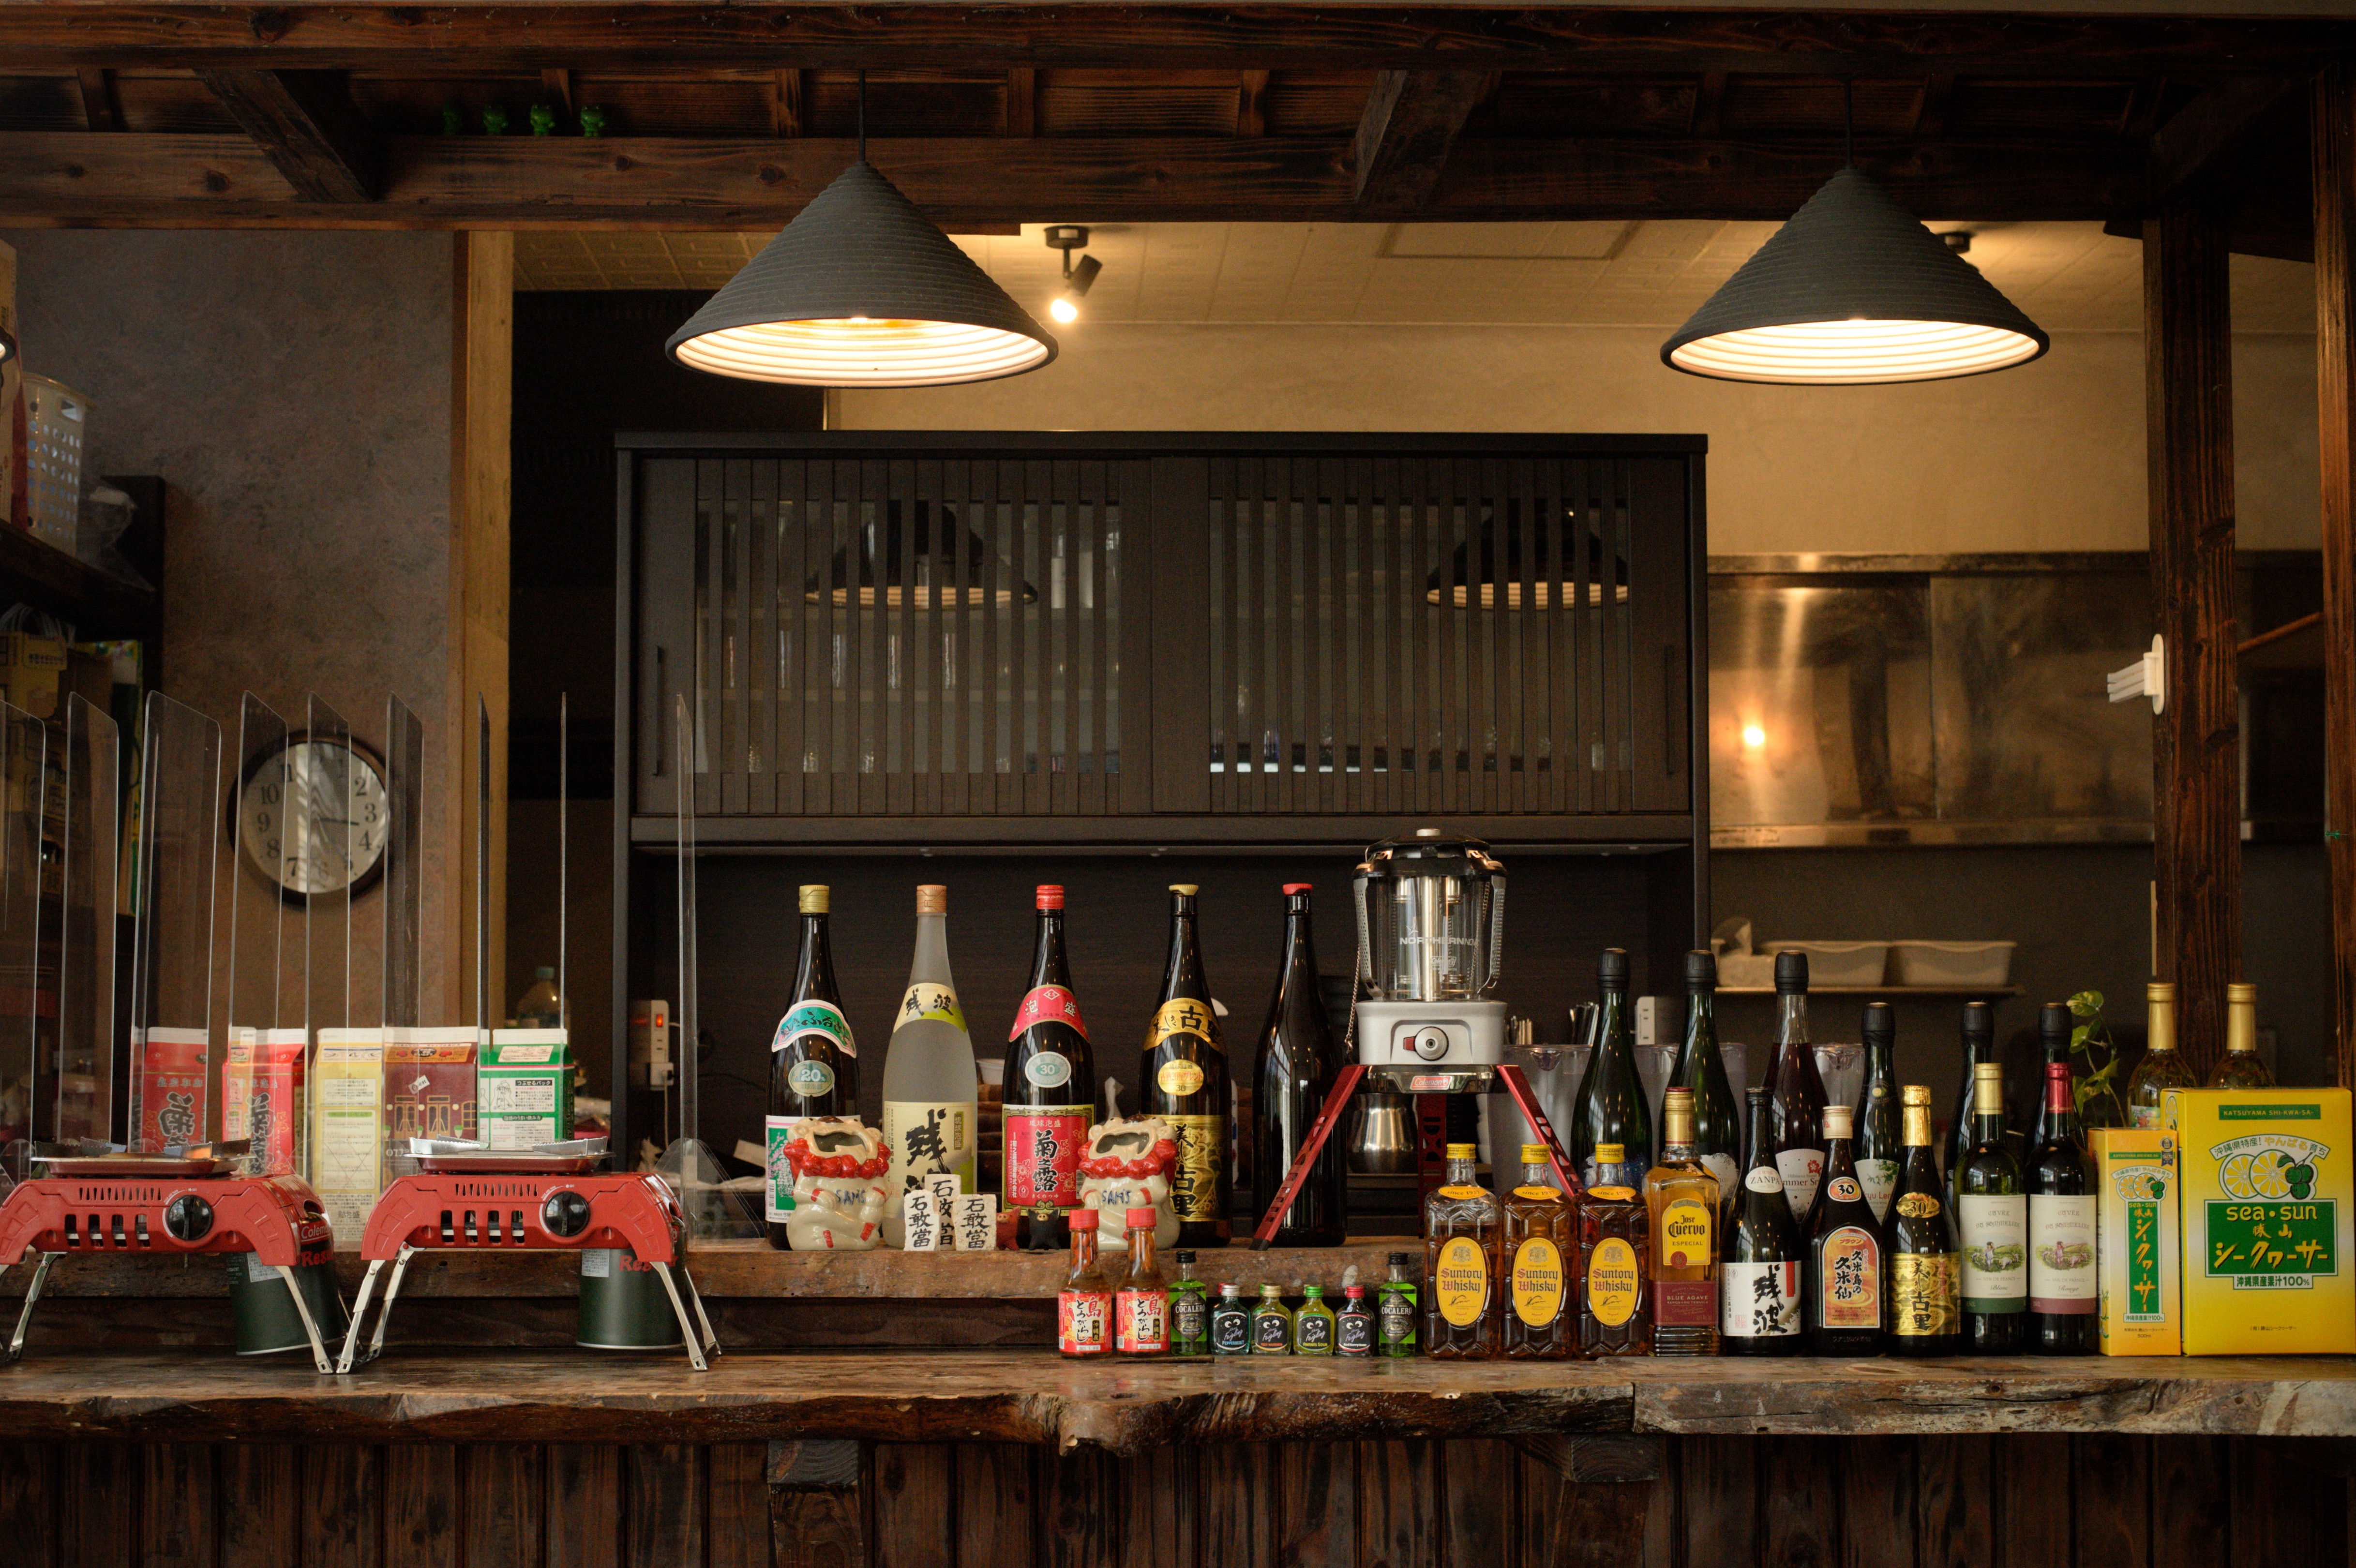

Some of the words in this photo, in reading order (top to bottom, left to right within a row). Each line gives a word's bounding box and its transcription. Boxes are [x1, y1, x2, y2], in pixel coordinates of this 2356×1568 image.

[261, 783, 279, 805] 10
[355, 777, 368, 797] 2
[364, 803, 377, 823] 3
[257, 812, 270, 833] 9
[359, 830, 372, 851] 4
[267, 838, 280, 859] 8
[287, 857, 299, 877] 7
[1040, 1064, 1055, 1075] 30
[1414, 1077, 1442, 1086] Coleman
[1029, 1119, 1061, 1128] 琉球泡盛
[1031, 1128, 1059, 1193] 菊之露
[1751, 1176, 1781, 1185] ZANPA
[1837, 1184, 1855, 1195] 30
[1908, 1201, 1927, 1215] 30
[909, 1195, 934, 1248] 石敢當
[961, 1198, 990, 1248] 石敢當
[1681, 1215, 1696, 1225] Jose
[1985, 1220, 2020, 1229] SOMMELIER
[2055, 1222, 2090, 1230] SOMMELIER
[1668, 1221, 1706, 1238] Cuervo
[1441, 1268, 1482, 1281] Suntory
[1516, 1268, 1558, 1282] Suntory
[1592, 1268, 1634, 1281] Suntory
[1834, 1256, 1852, 1300] 久米仙
[1851, 1249, 1863, 1294] 久米島の
[1442, 1280, 1481, 1294] Whisky
[1517, 1280, 1556, 1294] Whisky
[1593, 1280, 1633, 1294] Whisky
[2236, 1275, 2310, 1287] 沖縄県産果汁100%
[2058, 1285, 2079, 1293] Rouge
[1086, 1295, 1102, 1318] 島
[1147, 1294, 1162, 1316] 島
[1175, 1305, 1205, 1314] COCALERO
[1381, 1306, 1412, 1315] COCALERO
[1076, 1299, 1089, 1342] とうがらし
[1137, 1298, 1150, 1341] とうがらし
